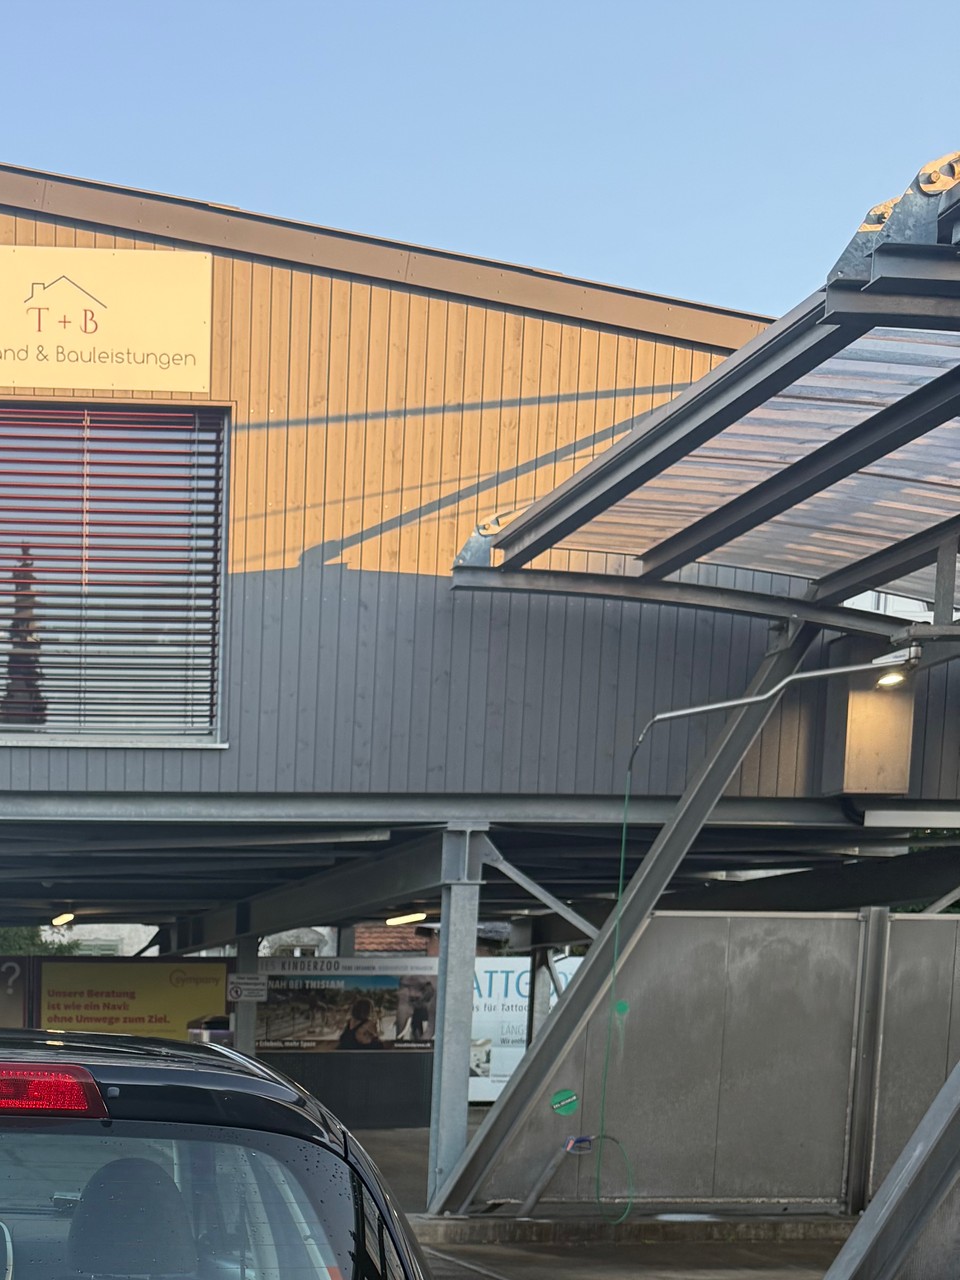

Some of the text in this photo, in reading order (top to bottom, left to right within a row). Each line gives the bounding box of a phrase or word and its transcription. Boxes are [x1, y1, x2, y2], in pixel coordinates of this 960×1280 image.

[26, 307, 49, 333] T
[79, 308, 99, 334] B
[35, 344, 50, 362] &
[56, 345, 197, 370] Bauleistungen
[280, 959, 341, 972] KINDERZOO
[47, 989, 136, 1000] Unsere Beratung
[47, 1001, 62, 1011] ist
[64, 1001, 81, 1011] wie
[83, 1001, 101, 1011] ein
[47, 1014, 171, 1026] ohne Umwege zum Ziel.
